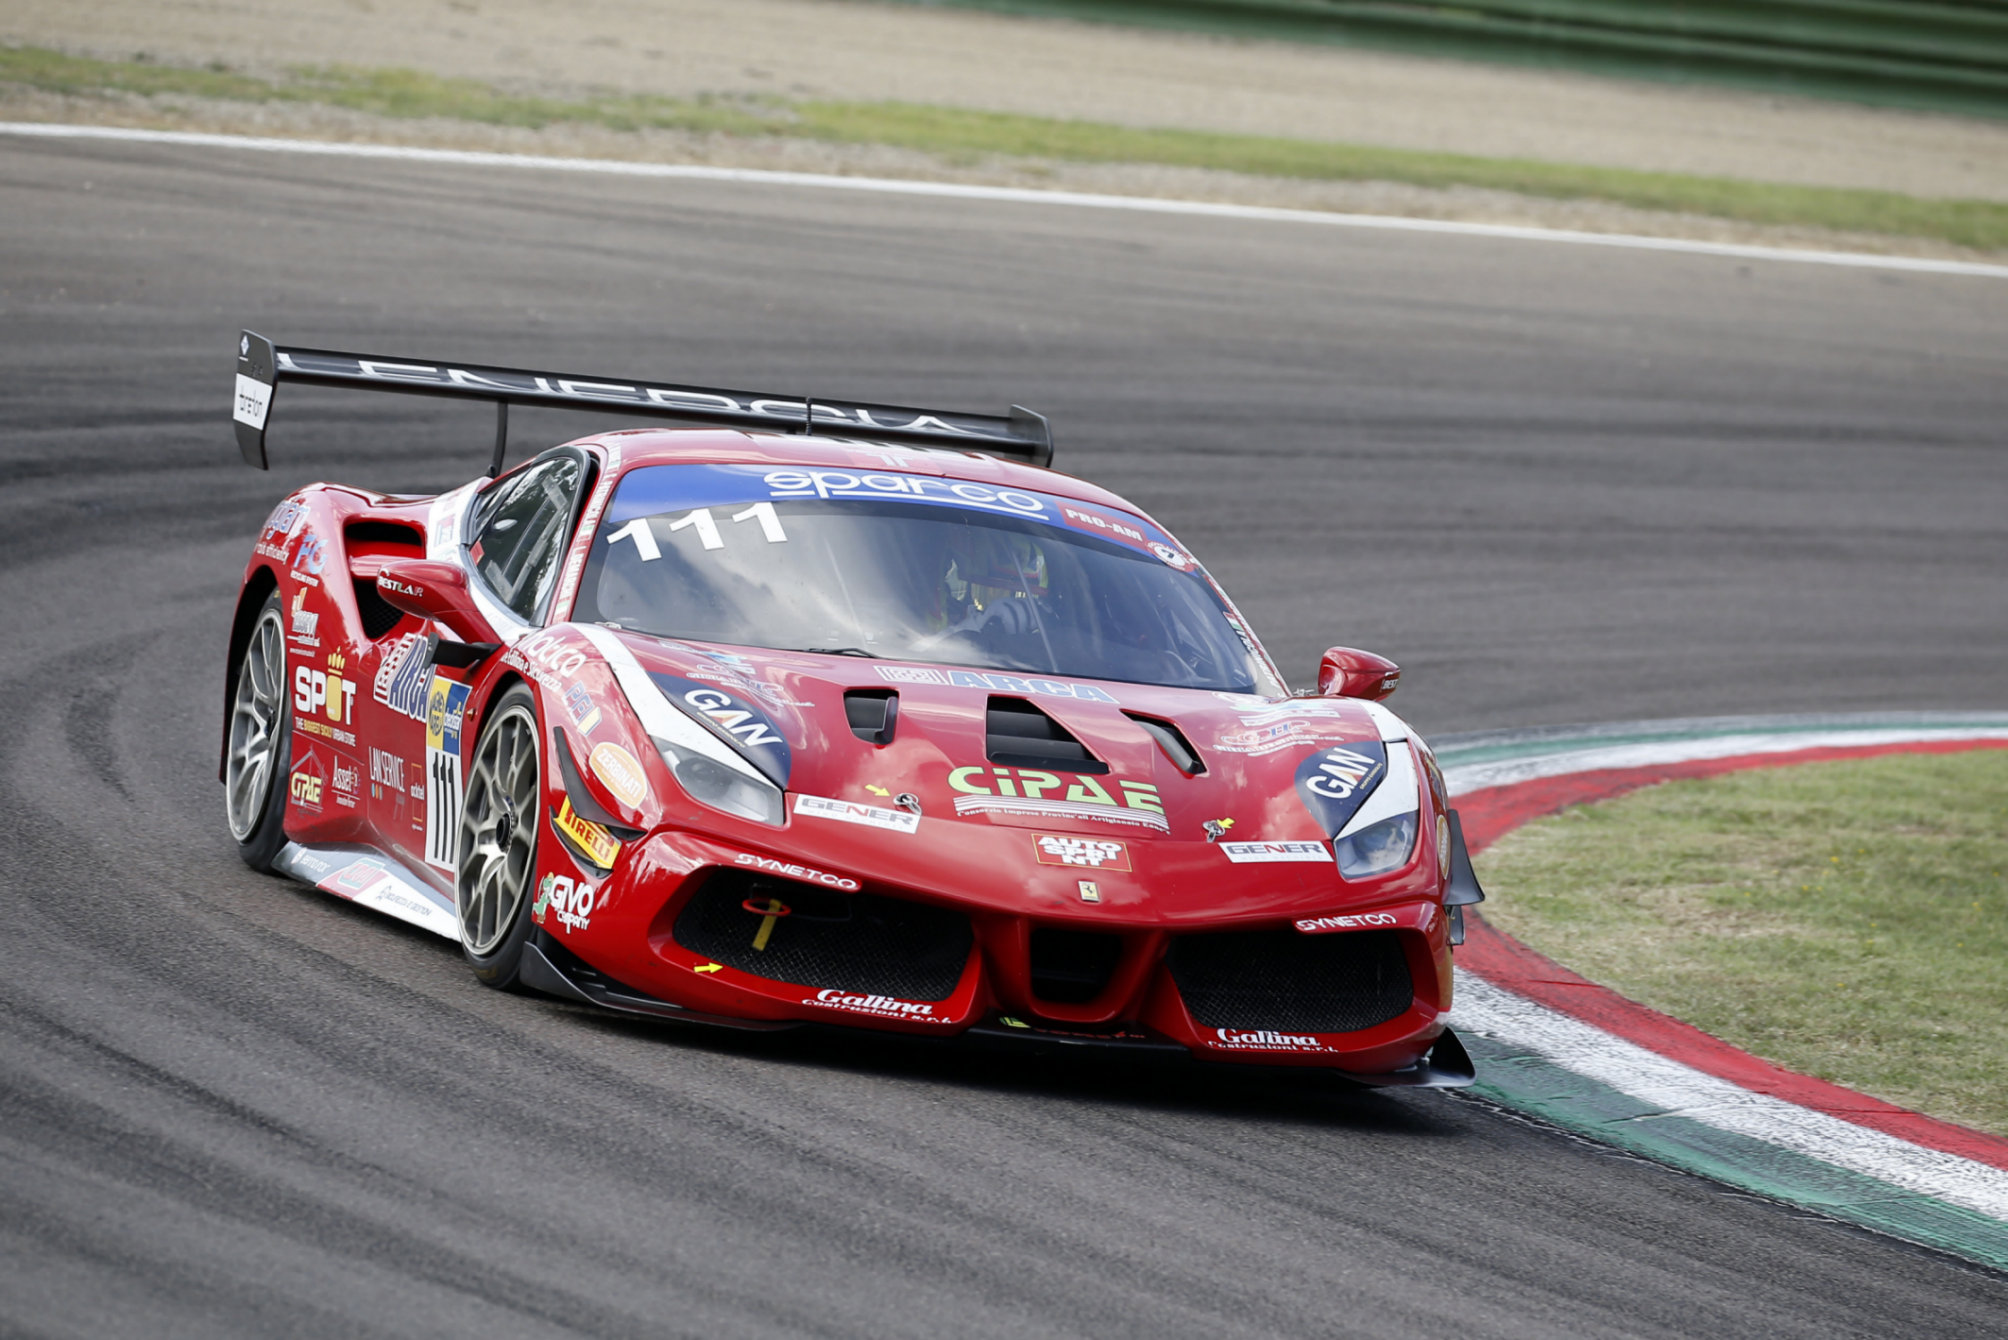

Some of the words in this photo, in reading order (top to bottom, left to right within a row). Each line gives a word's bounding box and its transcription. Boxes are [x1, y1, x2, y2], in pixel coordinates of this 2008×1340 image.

[763, 471, 1044, 512] sparco
[607, 501, 788, 562] 111
[1065, 508, 1143, 542] PRO-AM
[294, 534, 328, 575] FG
[294, 665, 357, 726] SPOT
[947, 670, 1120, 704] ARCA
[684, 689, 783, 747] GAN
[597, 748, 643, 798] ZERBINATI
[1306, 747, 1376, 799] GAN
[433, 752, 456, 864] 111
[801, 798, 914, 825] GENER
[1003, 808, 1040, 818] Imprese
[564, 806, 614, 861] PIRELLI
[1038, 837, 1122, 852] AUTO
[1226, 844, 1323, 855] GENER
[1044, 845, 1117, 860] SPRI
[1061, 855, 1104, 866] NT
[734, 853, 857, 889] SYNETCO
[549, 875, 594, 917] GIVO
[1296, 913, 1397, 931] SYNETCO
[802, 999, 907, 1018] Costruzioni
[817, 989, 932, 1015] Gallina
[1208, 1041, 1299, 1051] Costruzioni
[1216, 1028, 1321, 1046] Gallina
